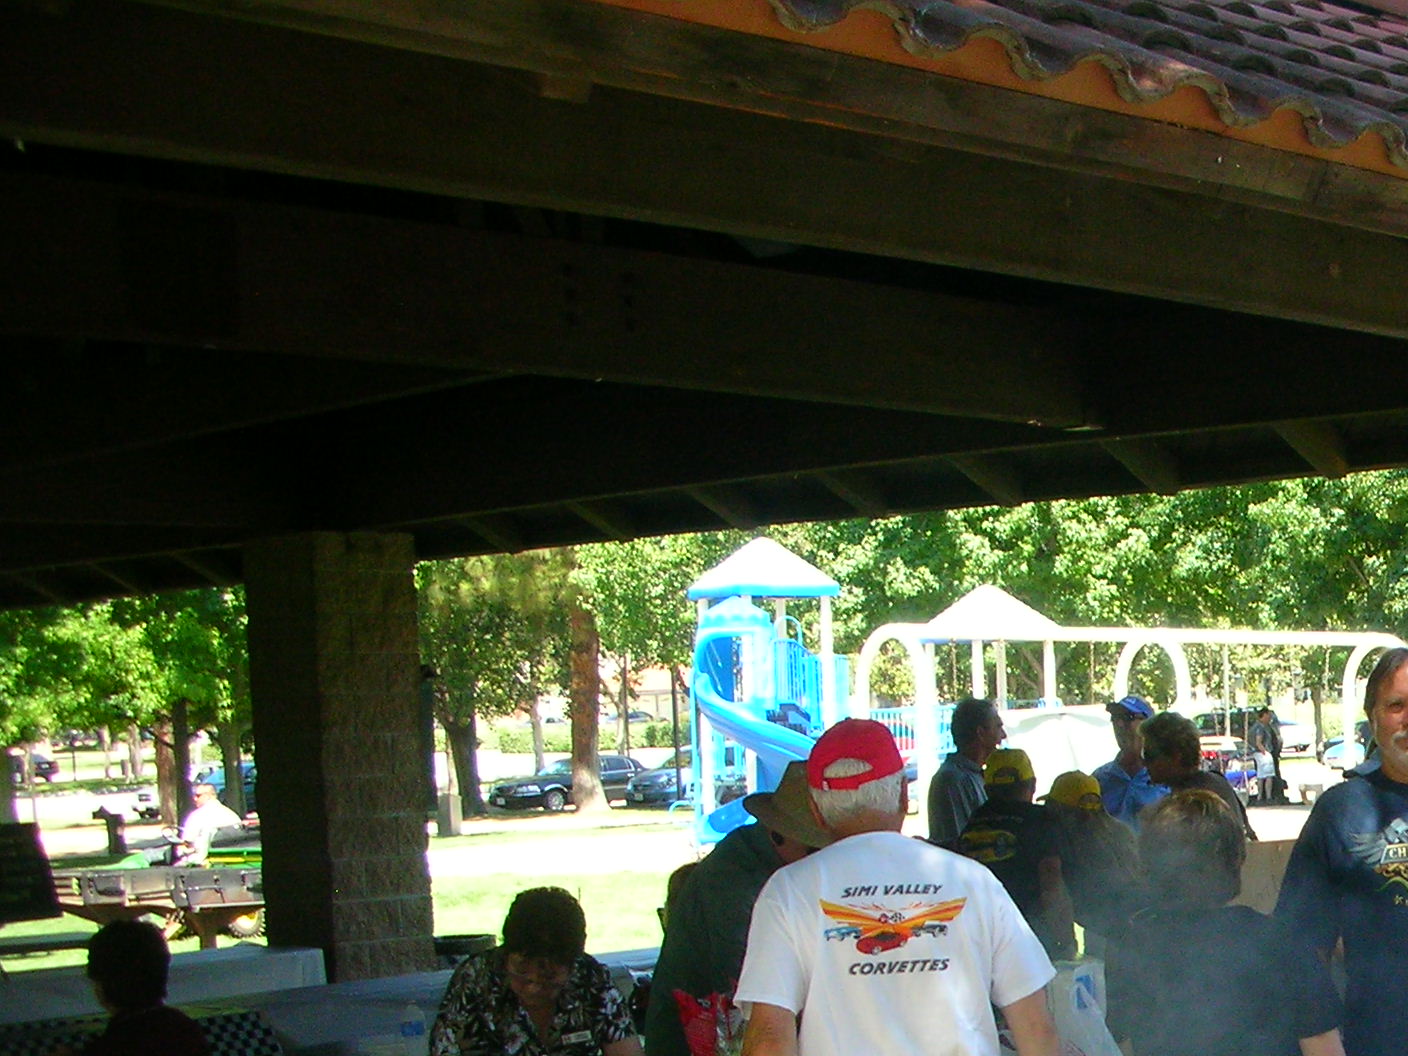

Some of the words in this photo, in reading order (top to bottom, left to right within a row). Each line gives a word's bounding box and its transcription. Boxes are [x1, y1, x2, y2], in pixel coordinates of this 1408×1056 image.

[841, 885, 878, 898] SIMI
[883, 884, 943, 896] VALLEY
[849, 958, 950, 975] CORVETTES
